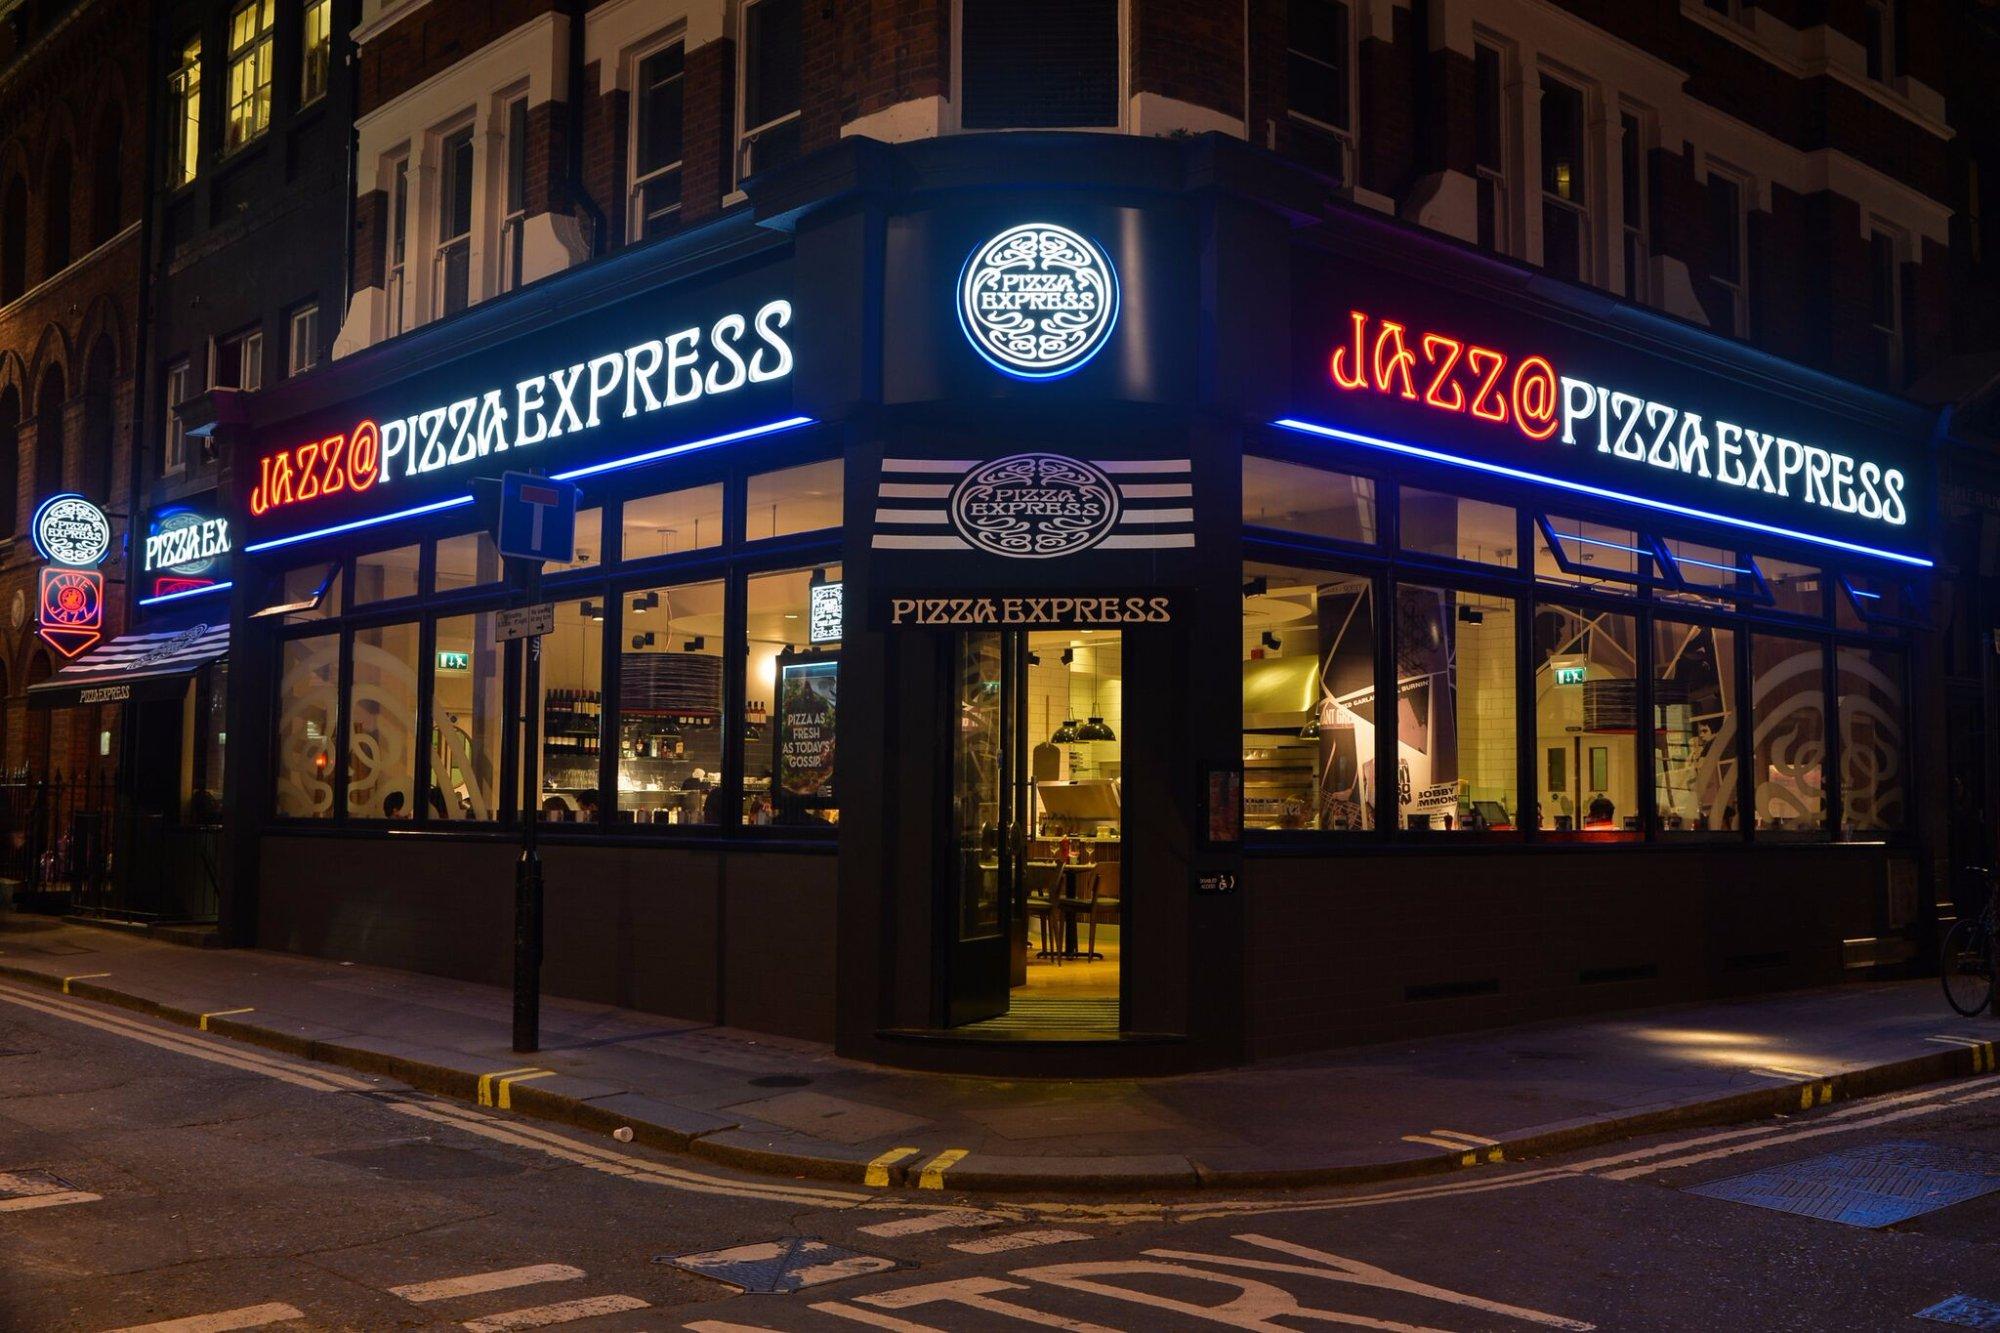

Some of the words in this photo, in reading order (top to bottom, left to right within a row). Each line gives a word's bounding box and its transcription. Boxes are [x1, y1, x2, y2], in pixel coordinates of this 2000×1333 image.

[1002, 274, 1075, 292] PIZZA
[981, 291, 1095, 310] EXPRESS
[995, 488, 1077, 502] PIZZA
[970, 502, 1100, 516] EXPRESS
[58, 520, 92, 532] PIZZA
[48, 528, 102, 541] EXPRESS
[54, 574, 91, 590] LIVE
[50, 604, 93, 624] JAZZ
[788, 713, 813, 726] PIZZA
[814, 712, 825, 724] AS
[793, 727, 820, 739] FRESH
[783, 742, 794, 754] AS
[795, 740, 830, 753] TODAY'S
[1419, 788, 1454, 800] BOBBY
